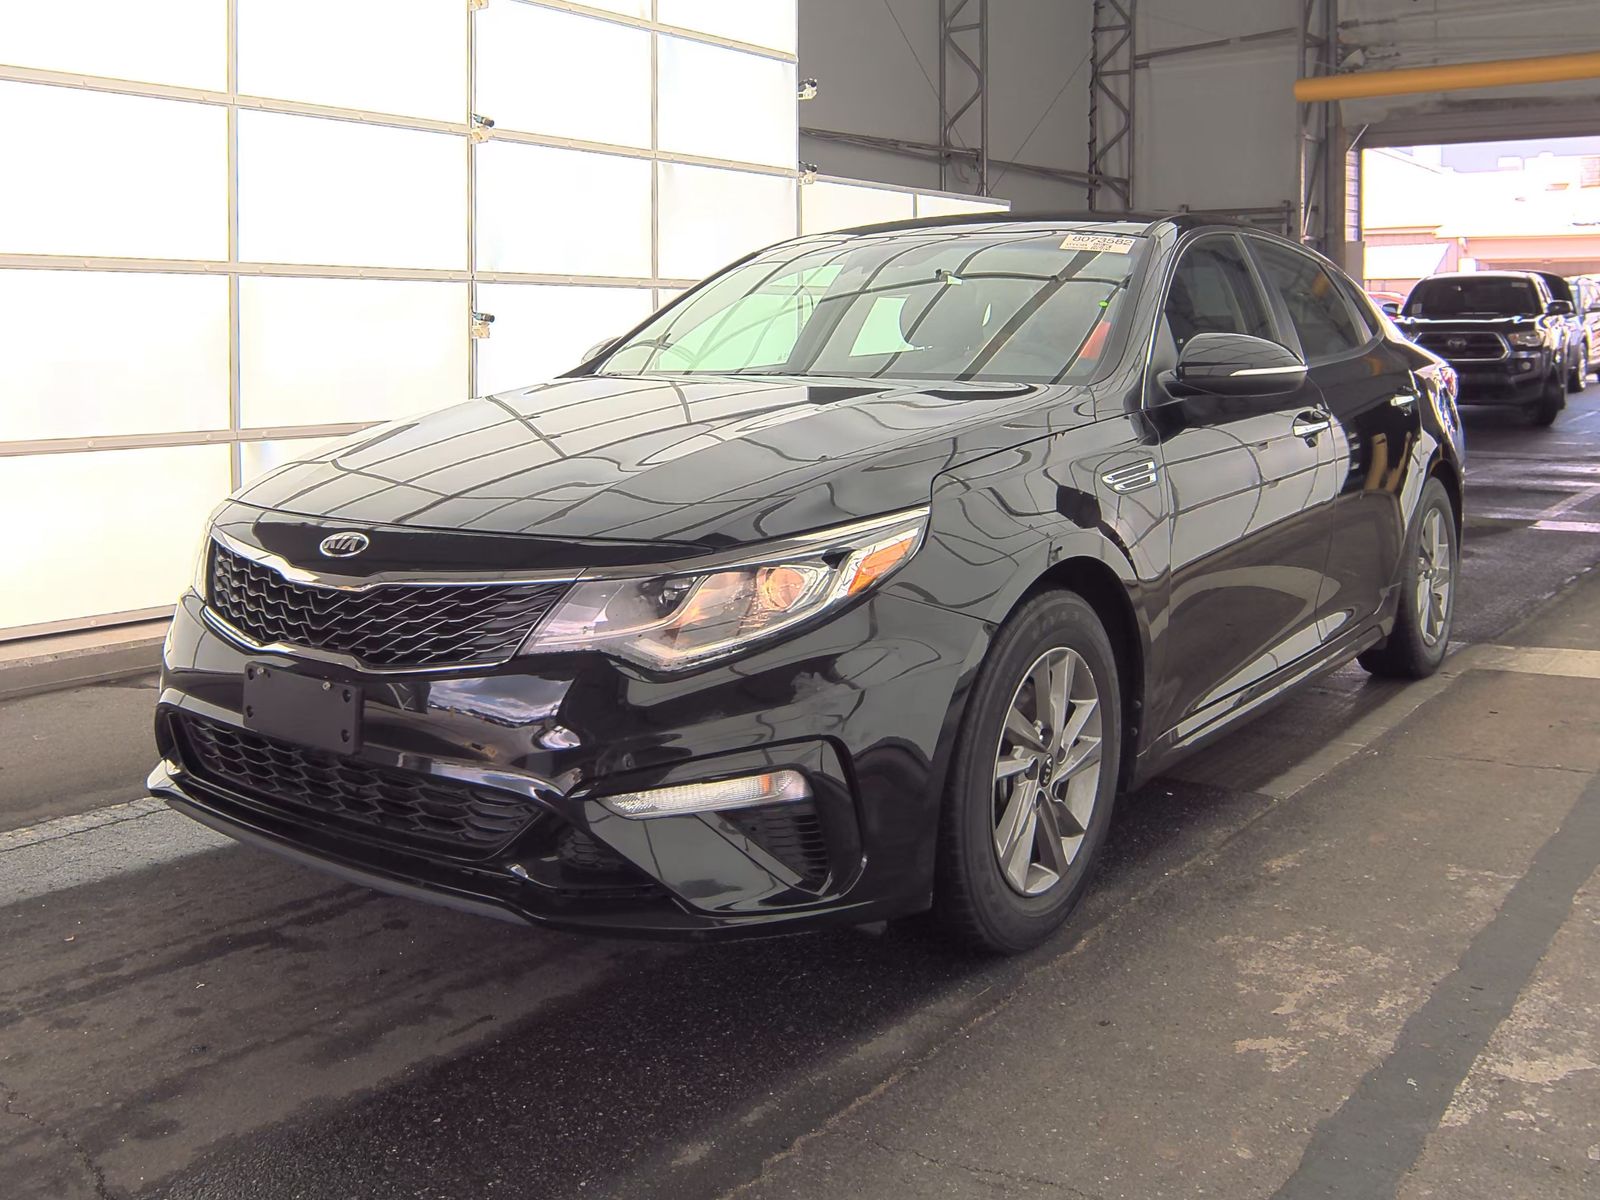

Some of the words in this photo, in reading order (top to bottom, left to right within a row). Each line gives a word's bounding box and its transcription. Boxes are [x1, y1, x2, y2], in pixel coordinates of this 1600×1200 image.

[1072, 236, 1133, 246] 8073582
[322, 534, 361, 552] KIA
[1042, 756, 1053, 785] KIA
